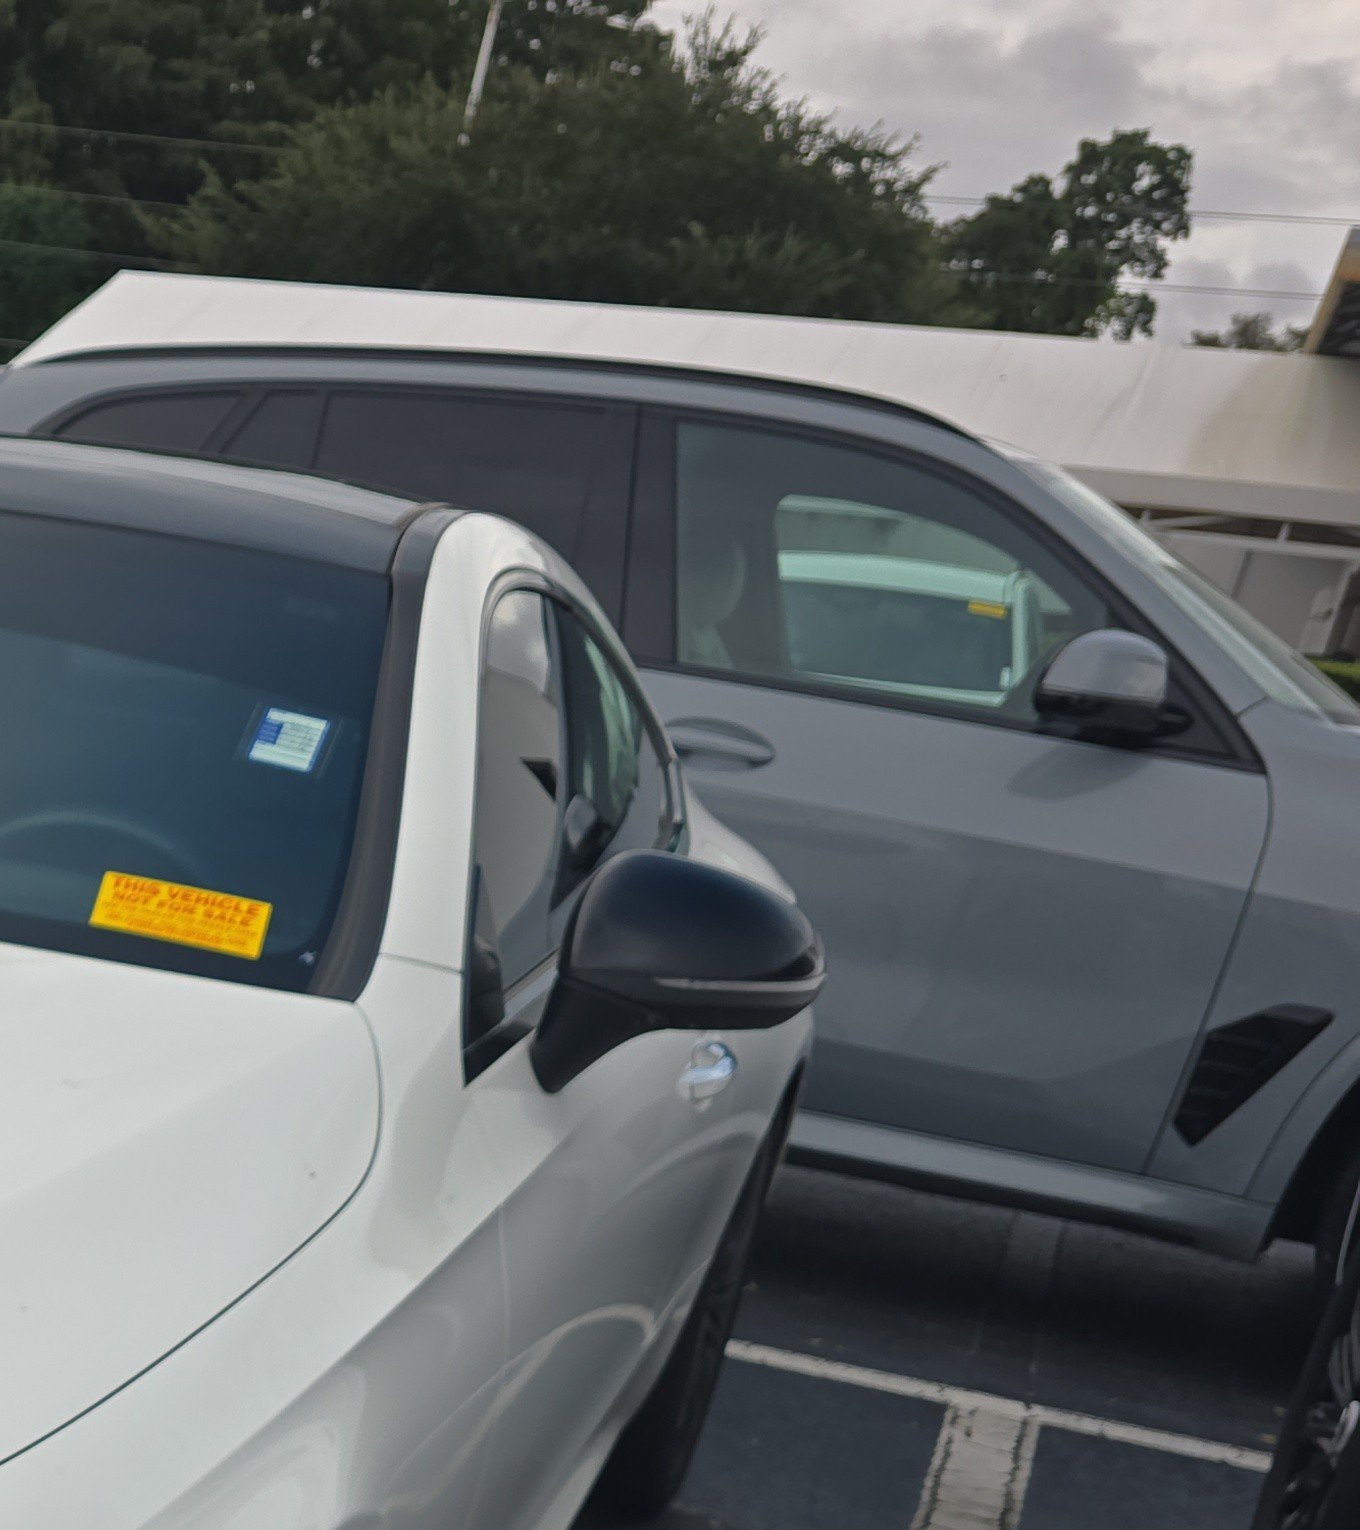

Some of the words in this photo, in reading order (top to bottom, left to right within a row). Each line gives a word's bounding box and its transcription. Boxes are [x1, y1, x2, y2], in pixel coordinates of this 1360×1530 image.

[112, 890, 153, 905] NOT
[156, 899, 197, 914] FOR
[202, 907, 256, 926] SALE
[113, 875, 160, 896] THIS
[168, 886, 262, 915] VEHICLE
